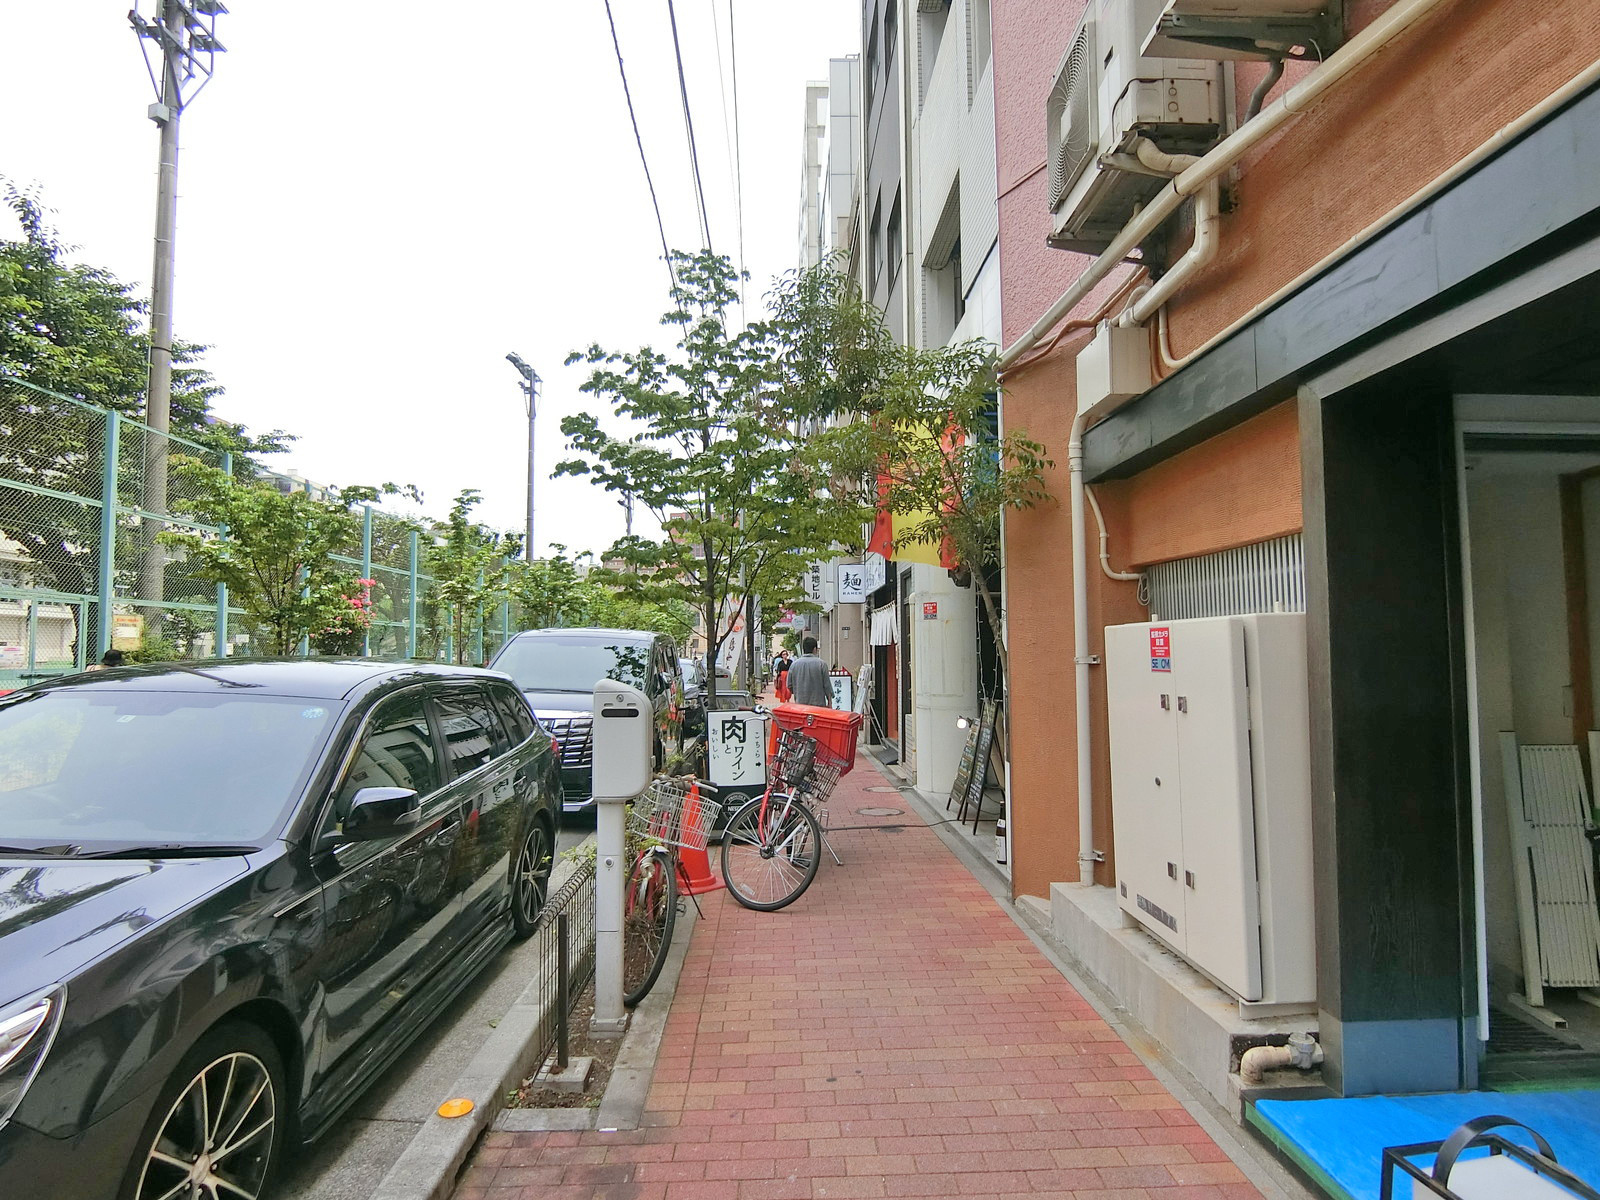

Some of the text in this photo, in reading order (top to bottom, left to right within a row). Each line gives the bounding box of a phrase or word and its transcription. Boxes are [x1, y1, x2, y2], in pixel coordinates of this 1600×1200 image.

[811, 565, 821, 600] 築地ビル
[842, 571, 862, 591] 麺
[1152, 658, 1170, 669] SEOM
[711, 728, 720, 760] おいしい
[721, 715, 747, 744] 肉
[731, 745, 746, 781] ワイン
